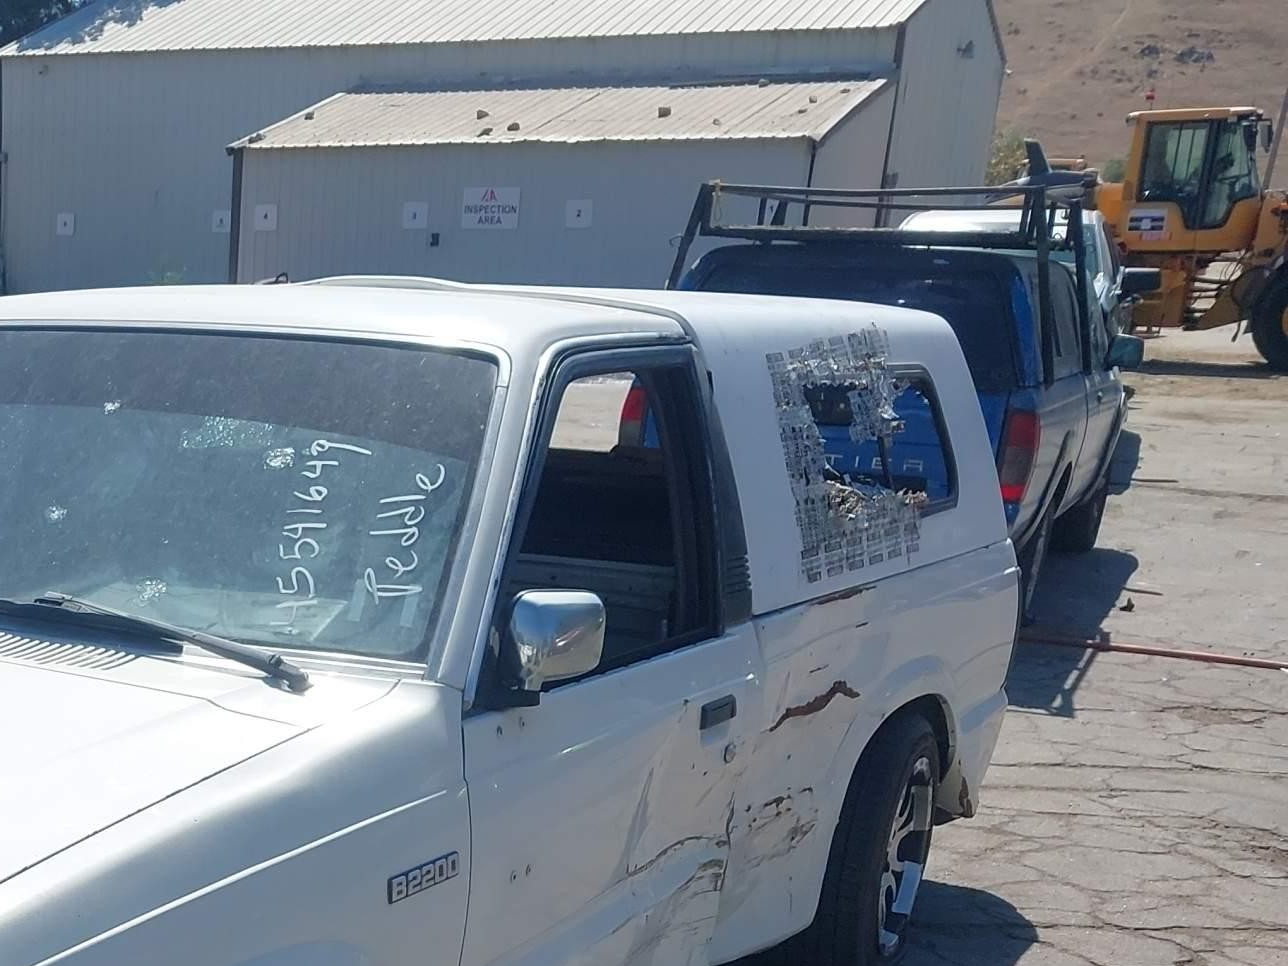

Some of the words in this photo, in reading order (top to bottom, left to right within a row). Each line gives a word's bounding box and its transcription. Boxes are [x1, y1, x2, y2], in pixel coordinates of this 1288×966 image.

[463, 204, 518, 215] INSPECTION
[477, 215, 503, 225] AREA
[269, 439, 373, 627] 45541649
[391, 852, 460, 903] B2200
